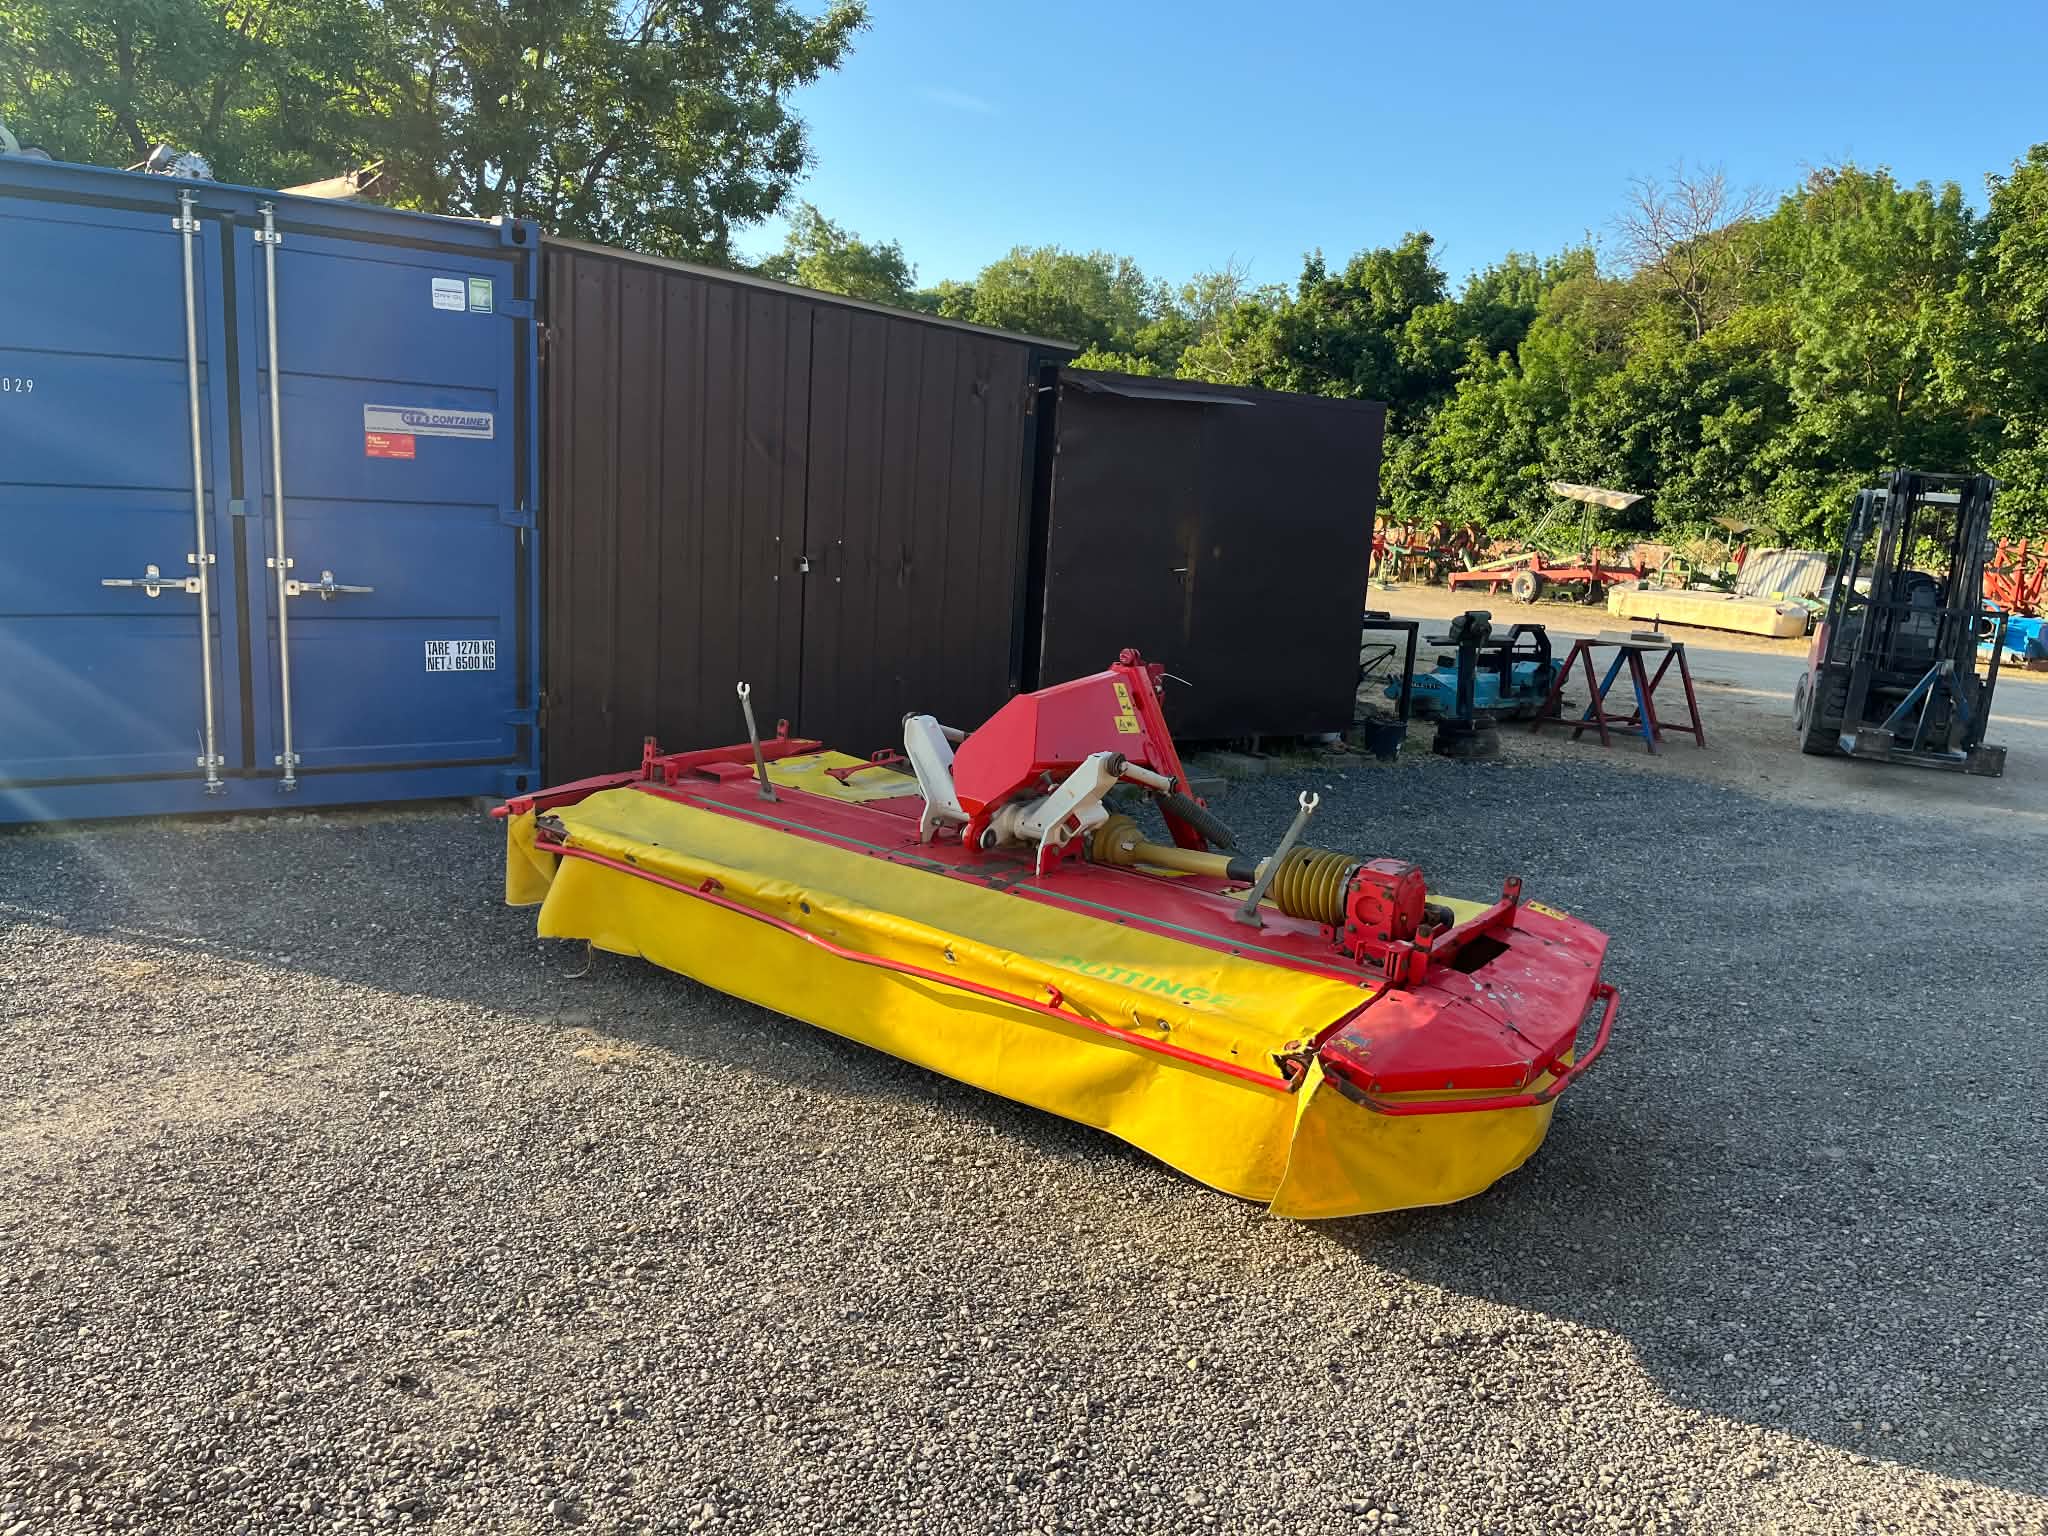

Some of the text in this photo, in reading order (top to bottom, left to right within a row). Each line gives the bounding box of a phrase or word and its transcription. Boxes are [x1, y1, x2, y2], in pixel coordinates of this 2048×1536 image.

[3, 377, 33, 392] 029
[432, 415, 490, 427] CONTAINEX
[426, 641, 495, 655] TARE 1270 KG
[427, 656, 495, 670] NET 6500 KG
